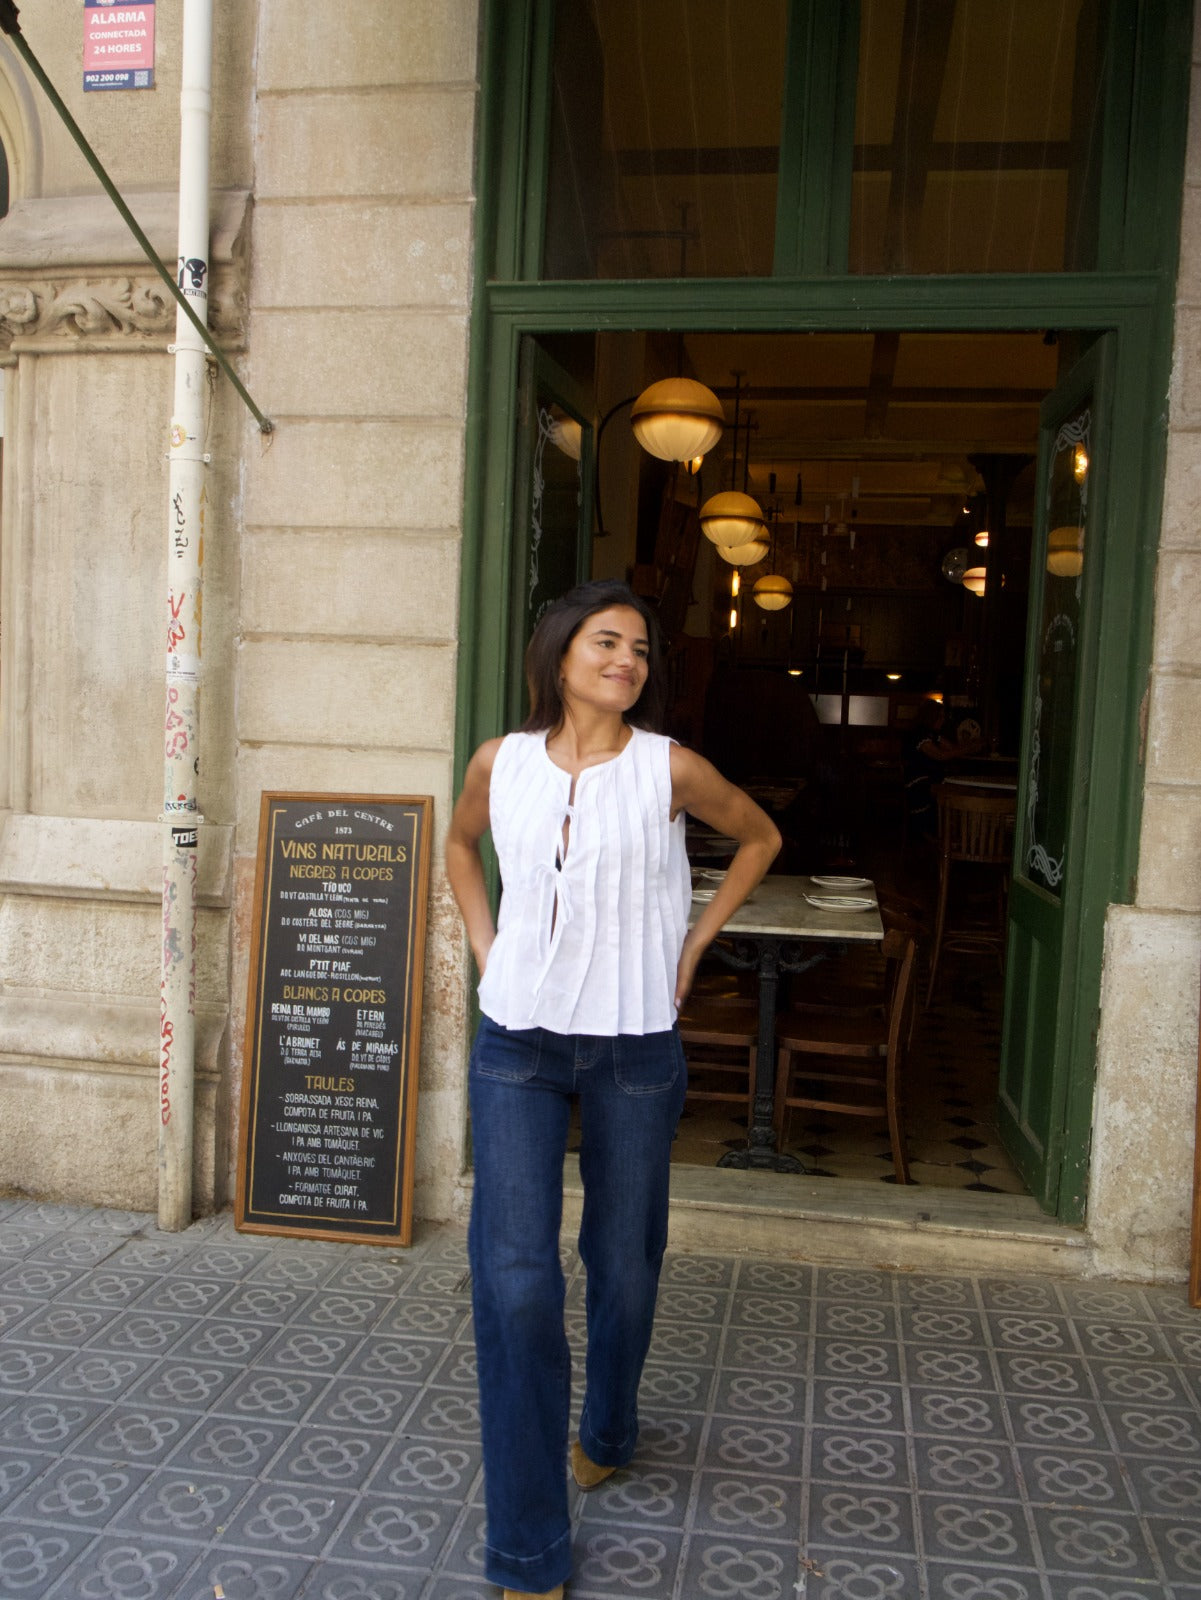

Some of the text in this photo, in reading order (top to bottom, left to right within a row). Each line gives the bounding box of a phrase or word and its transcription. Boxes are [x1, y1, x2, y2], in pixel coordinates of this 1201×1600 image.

[90, 11, 146, 25] ALARMA
[89, 29, 147, 40] CONNECTADA
[93, 43, 142, 54] 24 HORES
[100, 74, 115, 82] 200
[327, 809, 349, 818] DEL
[354, 810, 395, 832] CENTRE
[335, 826, 353, 835] 1873
[280, 840, 407, 863] VINS NATURALS
[290, 864, 394, 881] NEGRES A COPES
[337, 882, 352, 893] UCO
[297, 891, 324, 901] CASTILLA
[308, 907, 333, 918] ALOSA
[291, 917, 318, 928] COSTERS
[320, 918, 332, 928] DEL
[298, 933, 307, 943] VI
[308, 933, 322, 944] DEL
[323, 934, 340, 945] MAS
[332, 960, 351, 972] PIAF
[283, 985, 386, 1004] BLANCS A COPES
[271, 1003, 291, 1014] REINA
[292, 1004, 305, 1016] DEL
[351, 1041, 362, 1052] DE
[305, 1075, 355, 1092] TAULES
[285, 1093, 332, 1106] SOBRASSADA
[334, 1095, 354, 1108] XESC
[283, 1106, 317, 1118] COMPOTA
[318, 1108, 329, 1119] DE
[330, 1109, 355, 1121] FRUITA
[275, 1121, 321, 1135] LLONGANISSA
[323, 1124, 359, 1138] ARTESANA
[360, 1127, 371, 1138] DE
[296, 1136, 305, 1147] PA
[306, 1137, 322, 1149] AMB
[282, 1151, 317, 1164] ANXOVES
[317, 1153, 332, 1165] DEL
[292, 1165, 302, 1177] PA
[303, 1166, 320, 1177] AMB
[294, 1181, 332, 1195] FORMATGE
[278, 1193, 312, 1206] COMPOTA
[313, 1196, 324, 1208] DE
[325, 1197, 350, 1209] FRUITA
